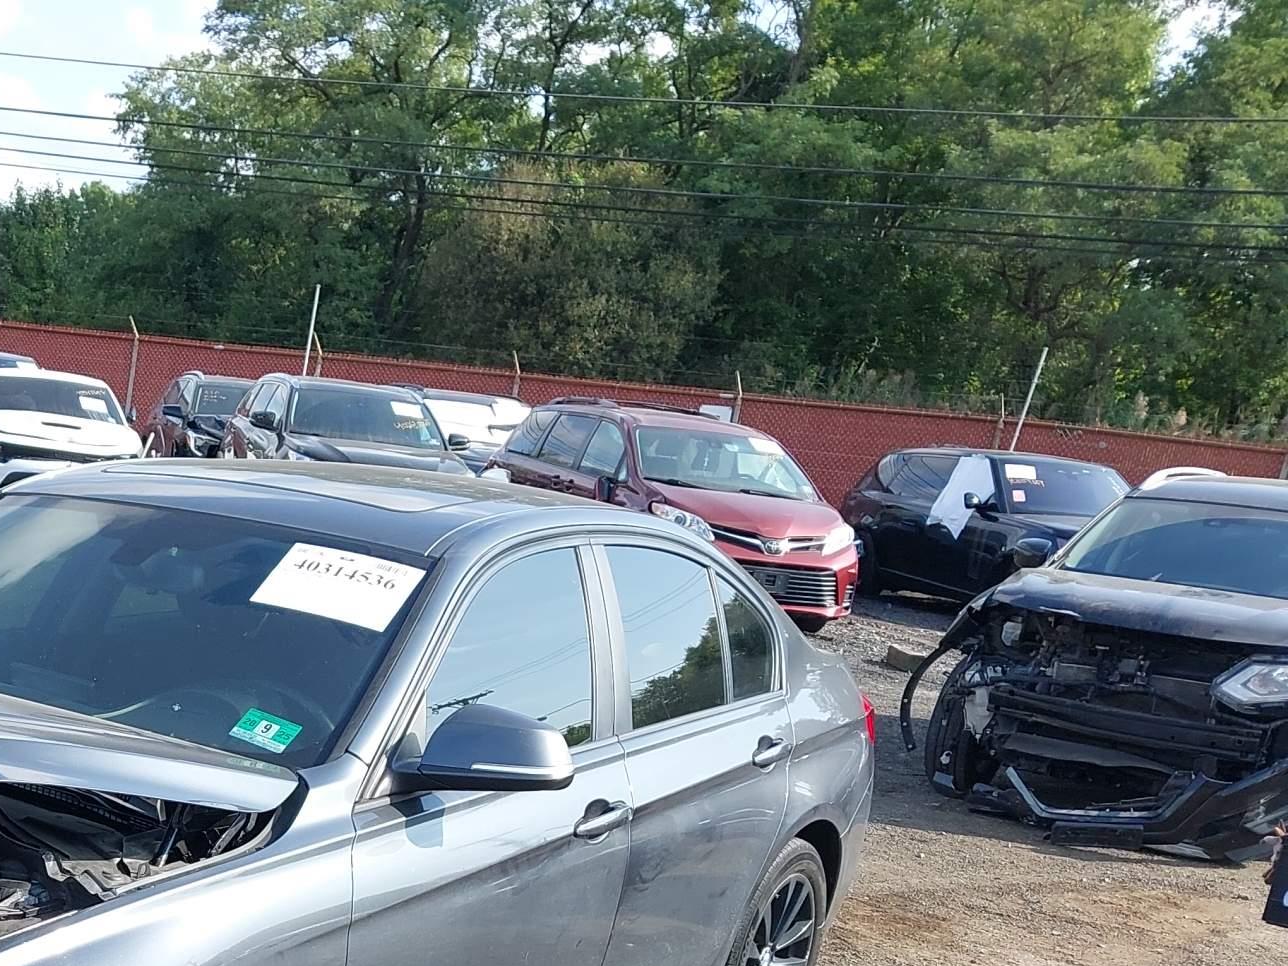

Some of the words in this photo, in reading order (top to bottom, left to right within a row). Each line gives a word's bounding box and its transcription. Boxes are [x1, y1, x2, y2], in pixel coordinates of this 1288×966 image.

[293, 559, 396, 591] 40314536
[261, 723, 273, 734] 9
[277, 730, 292, 740] 25
